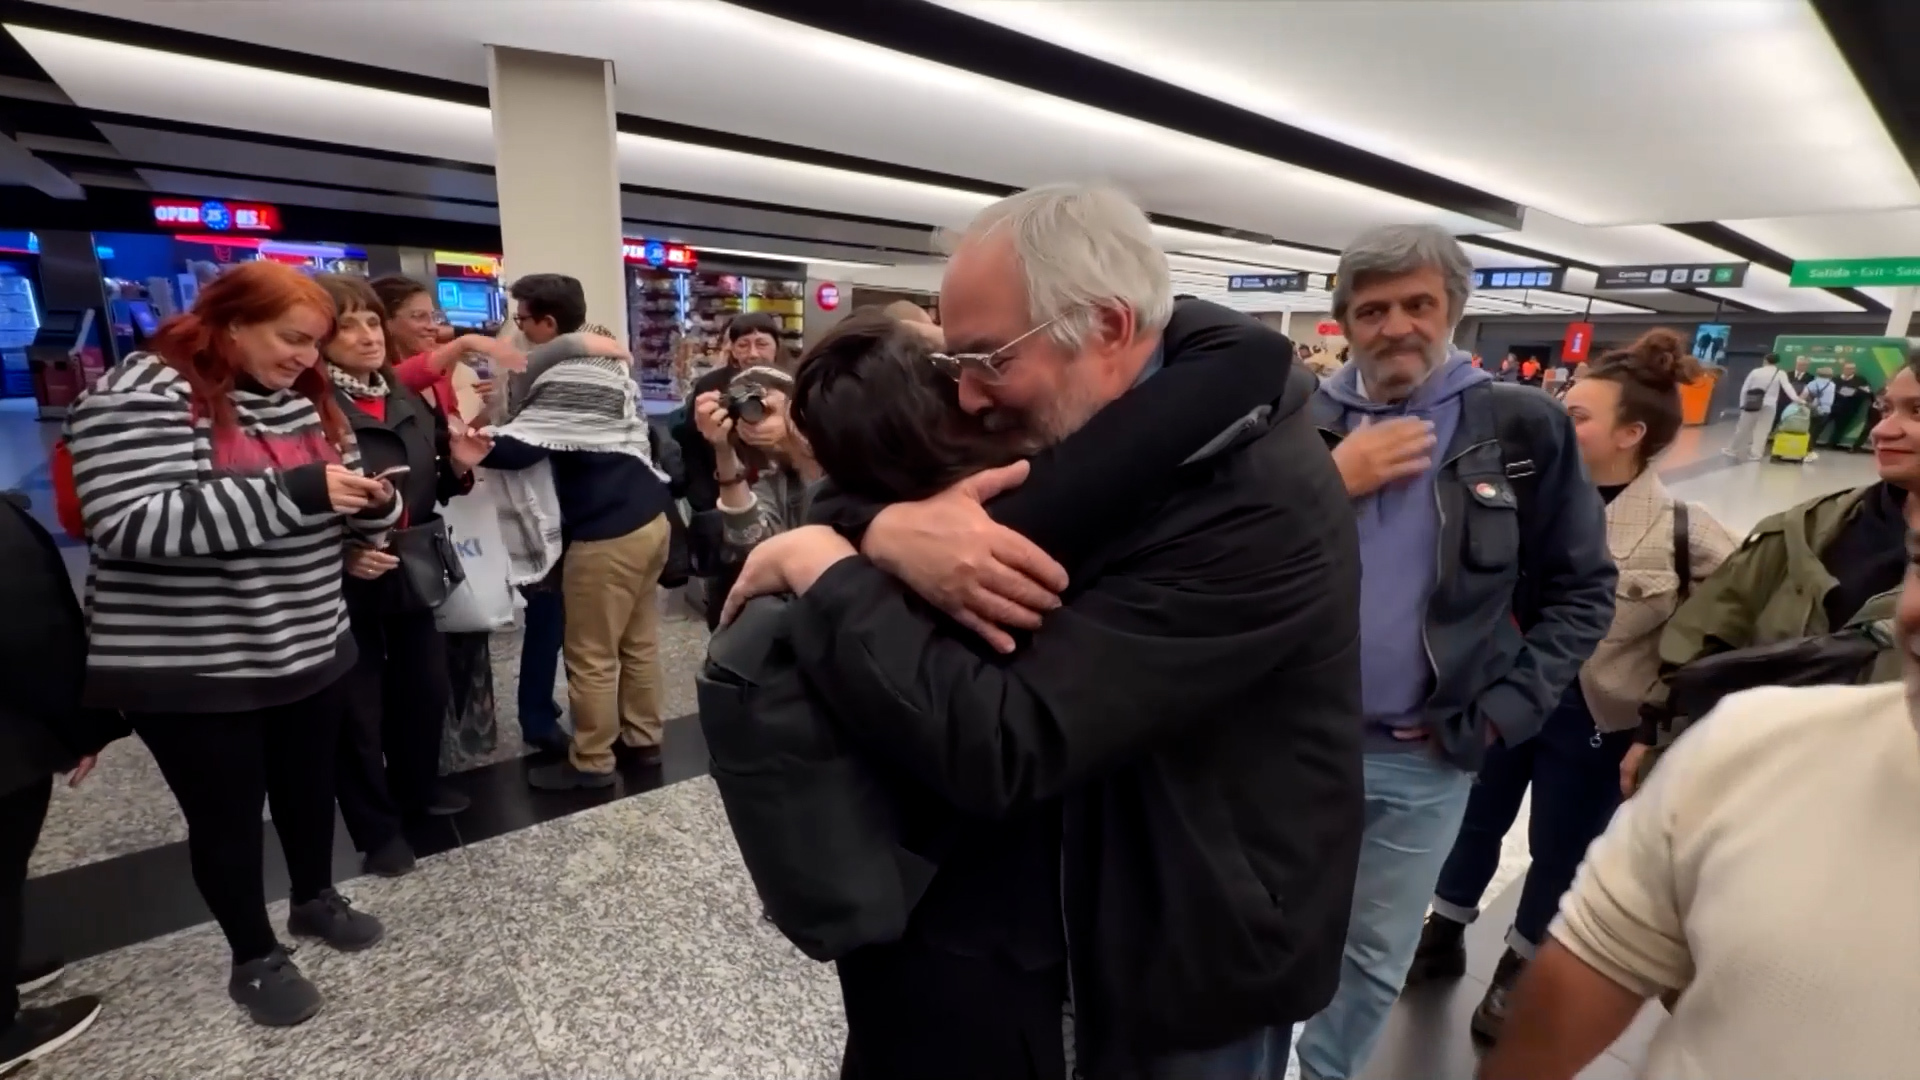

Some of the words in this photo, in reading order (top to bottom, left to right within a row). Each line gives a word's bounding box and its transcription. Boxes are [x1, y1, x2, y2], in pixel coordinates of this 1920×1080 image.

[154, 205, 199, 222] OPEN
[622, 245, 646, 259] PEN
[1809, 267, 1850, 278] Salida
